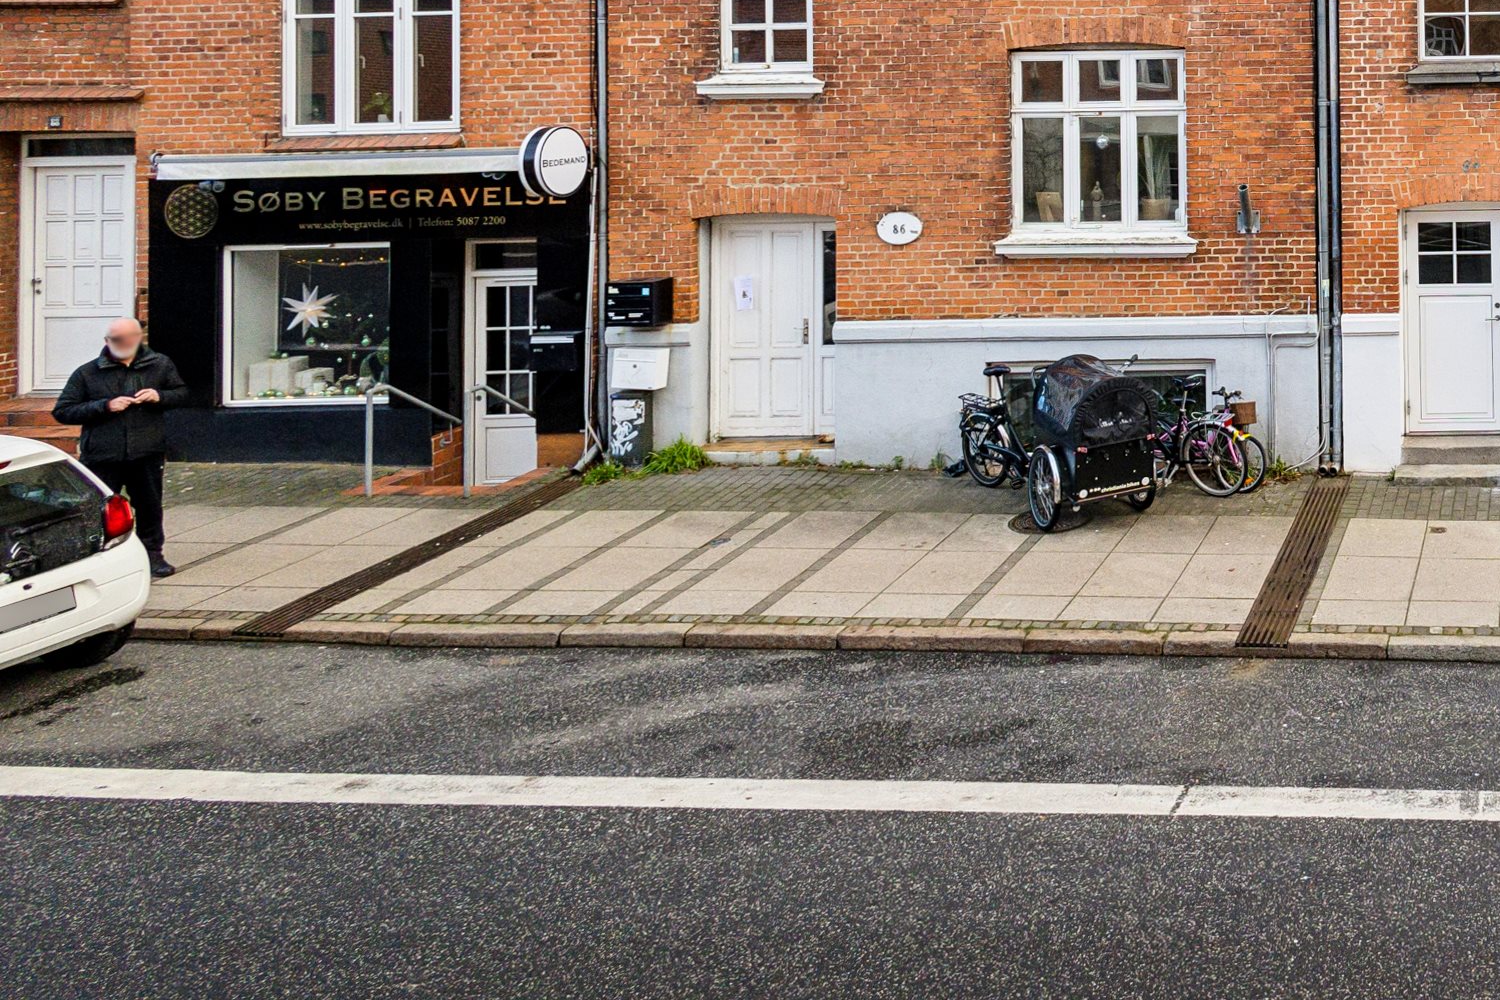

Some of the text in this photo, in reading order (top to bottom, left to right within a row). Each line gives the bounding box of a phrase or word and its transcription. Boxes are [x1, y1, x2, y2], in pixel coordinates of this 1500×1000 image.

[542, 156, 586, 168] BEDEMAND
[233, 190, 326, 213] SØBY
[417, 216, 454, 228] Telefon:
[456, 216, 480, 226] 5087
[482, 215, 507, 226] 2200
[892, 223, 906, 235] 86
